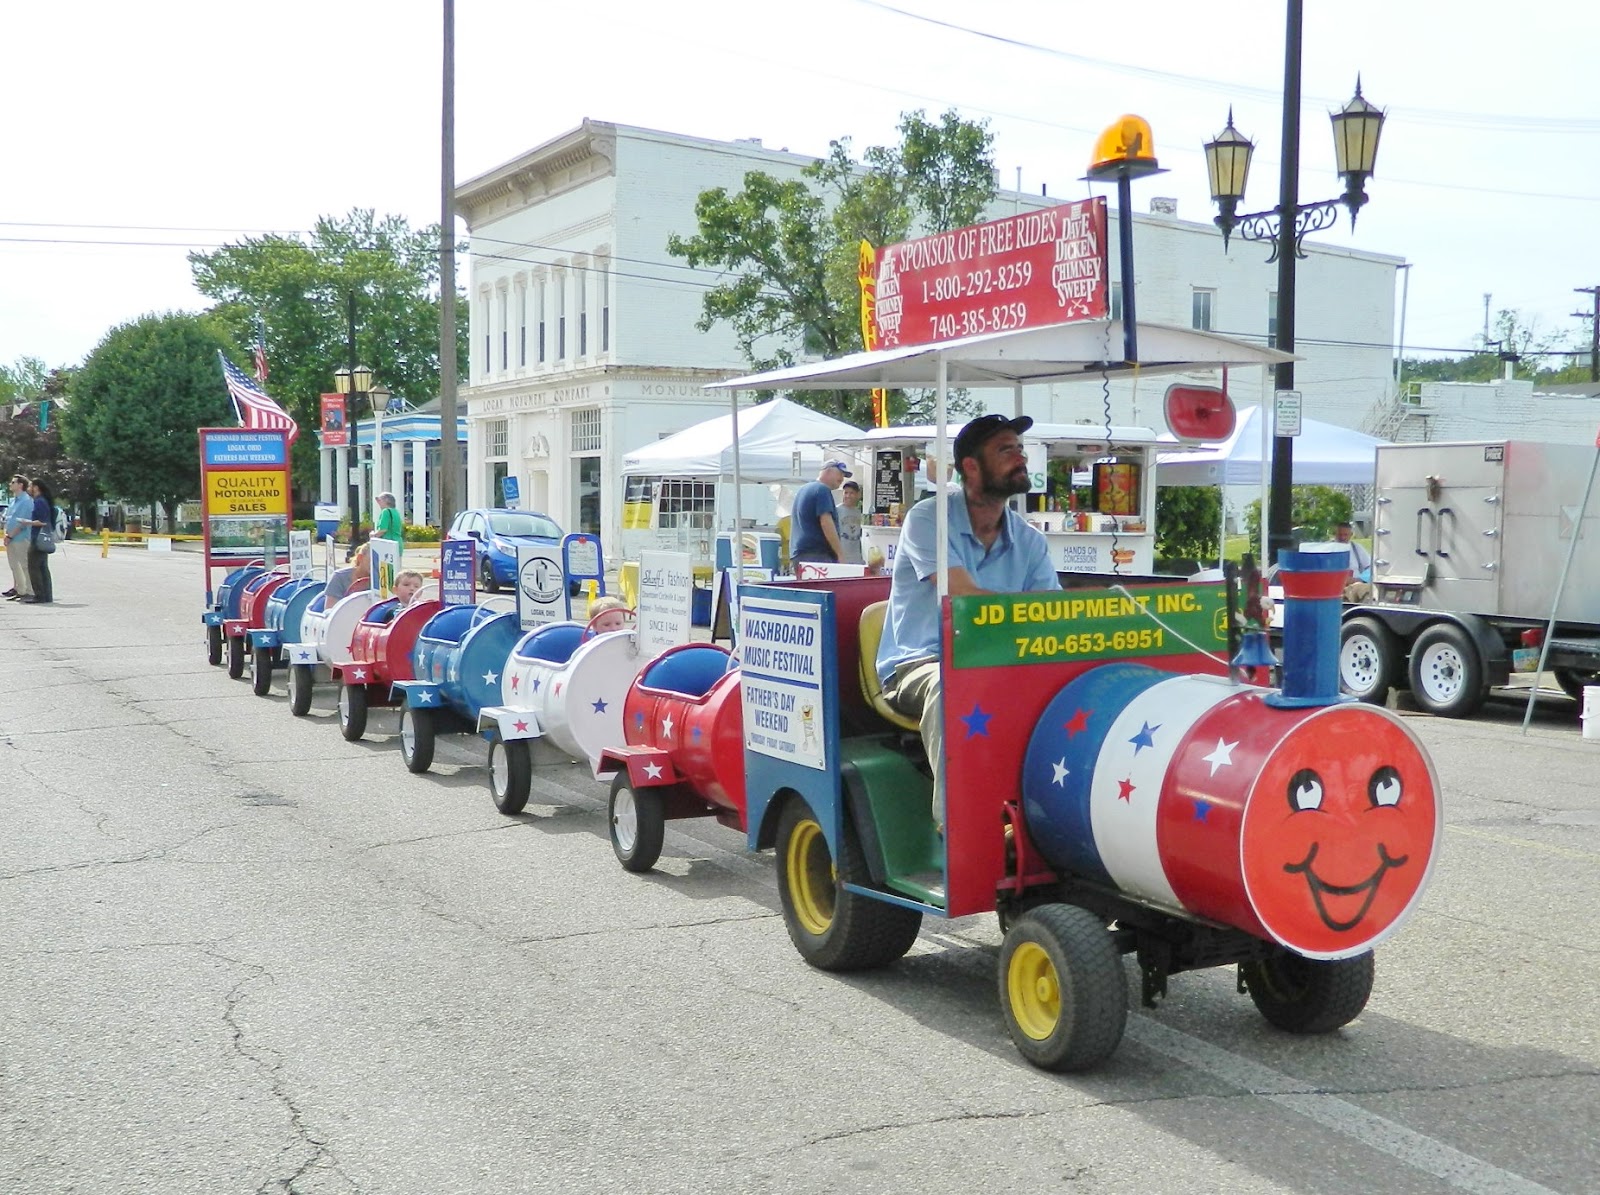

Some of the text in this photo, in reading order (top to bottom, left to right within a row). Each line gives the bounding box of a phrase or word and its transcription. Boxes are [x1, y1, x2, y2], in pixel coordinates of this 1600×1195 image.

[1062, 213, 1090, 241] DAVE
[900, 211, 1058, 273] SPONSOR OF FREE RIDES
[1055, 231, 1097, 263] DICKEN
[921, 261, 1032, 304] 1-800-292-8259
[1052, 257, 1101, 289] CHIMNEY
[1057, 278, 1097, 307] SWEEP
[929, 303, 1027, 340] 740-385-8259
[483, 386, 590, 412] LOGAN MONUMENT COMPANY
[215, 489, 280, 498] MOTORLAND
[217, 477, 276, 488] QUALITY
[229, 503, 267, 512] SALES
[1063, 546, 1097, 554] HANDS ON
[1063, 555, 1097, 563] CONCESSIONS
[973, 593, 1202, 625] JD EQUIPMENT INC.
[649, 620, 664, 632] SINCE
[745, 618, 814, 647] WASHBOARD
[1016, 629, 1163, 657] 740-653-6951
[744, 646, 814, 676] MUSIC FESTIVAL
[746, 686, 795, 712] FATHER'S DAY
[755, 709, 788, 733] WEEKEND
